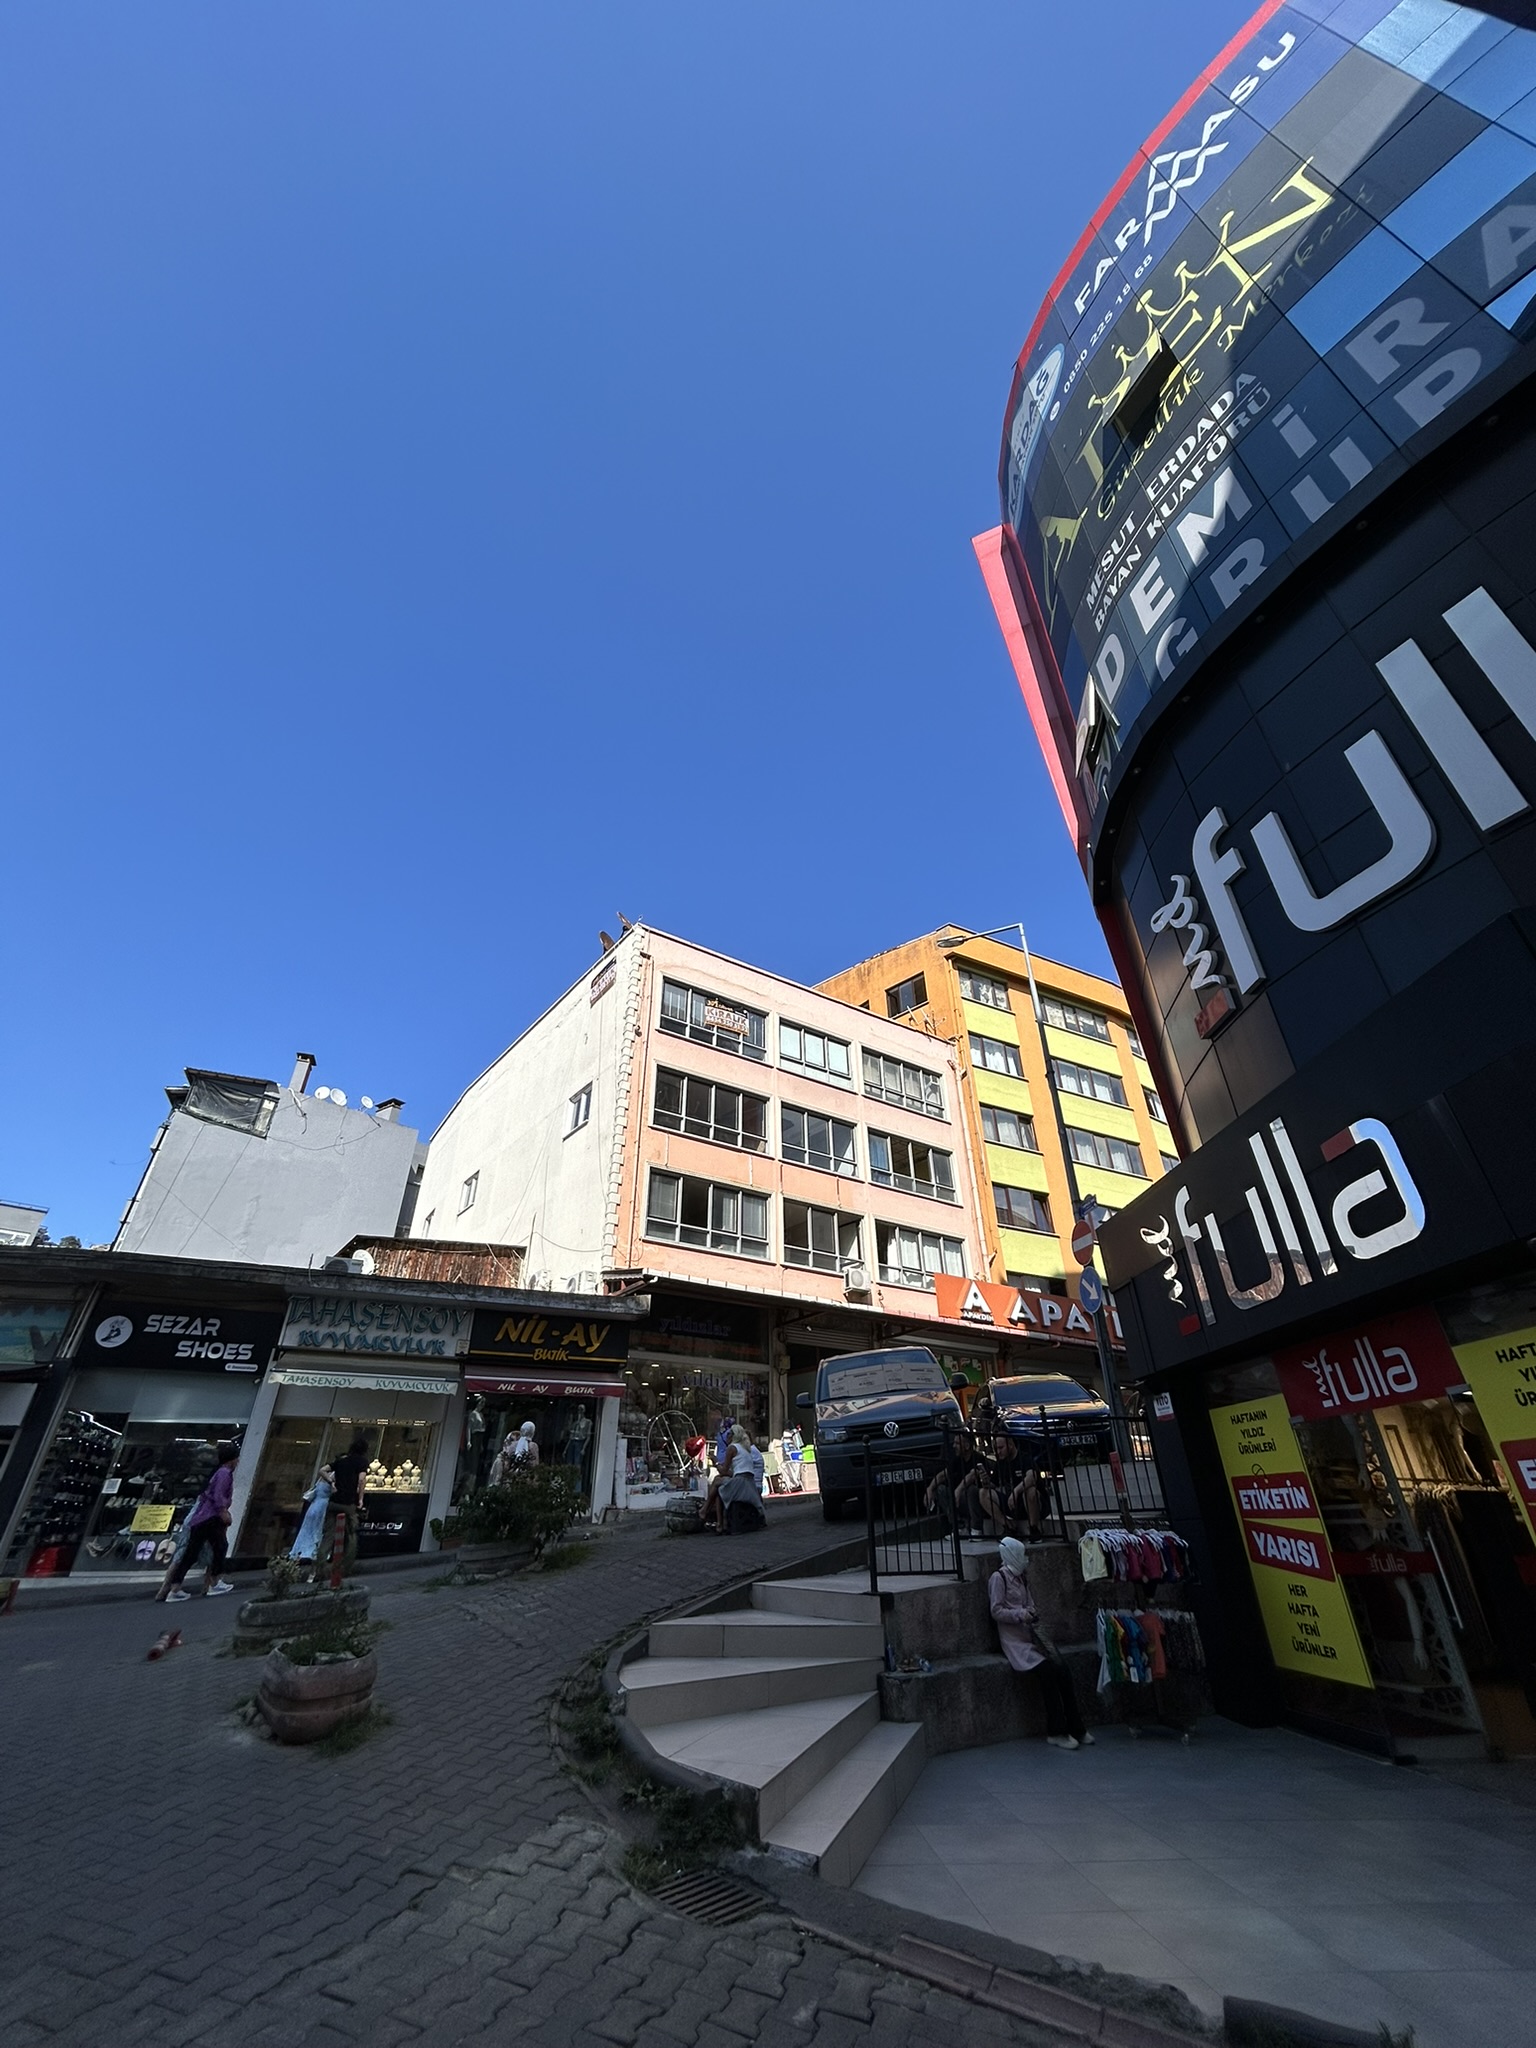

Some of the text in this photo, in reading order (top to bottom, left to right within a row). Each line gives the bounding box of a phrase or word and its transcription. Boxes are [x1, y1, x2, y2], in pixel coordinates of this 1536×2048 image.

[1063, 254, 1153, 394] 0850 225 18 68
[1097, 359, 1205, 522] Güzellik
[1086, 373, 1257, 610] MESUT ERDADA
[1094, 382, 1272, 633] BAYAN KUAFÖRÜ
[1175, 1116, 1426, 1327] fulla
[143, 1314, 221, 1336] SEZAR
[287, 1295, 471, 1337] TAHAŞENSOY
[174, 1340, 255, 1360] SHOES
[298, 1329, 447, 1356] KUYUMCULUK
[281, 1373, 450, 1393] TAHAŞENSOY KUYUMCULUK
[1319, 1336, 1418, 1406] fulla
[532, 1385, 549, 1394] AY
[1230, 1410, 1268, 1425] HAFTANIN
[1240, 1426, 1266, 1440] YILDIZ
[1238, 1438, 1277, 1455] ÜRÜNLERİ
[1238, 1480, 1311, 1510] ETİKETİN
[1251, 1530, 1320, 1569] YARISI
[1288, 1583, 1308, 1598] HER
[1288, 1602, 1319, 1618] HAFTA
[1297, 1621, 1320, 1637] YENİ
[1291, 1636, 1338, 1660] ÜRÜNLER
